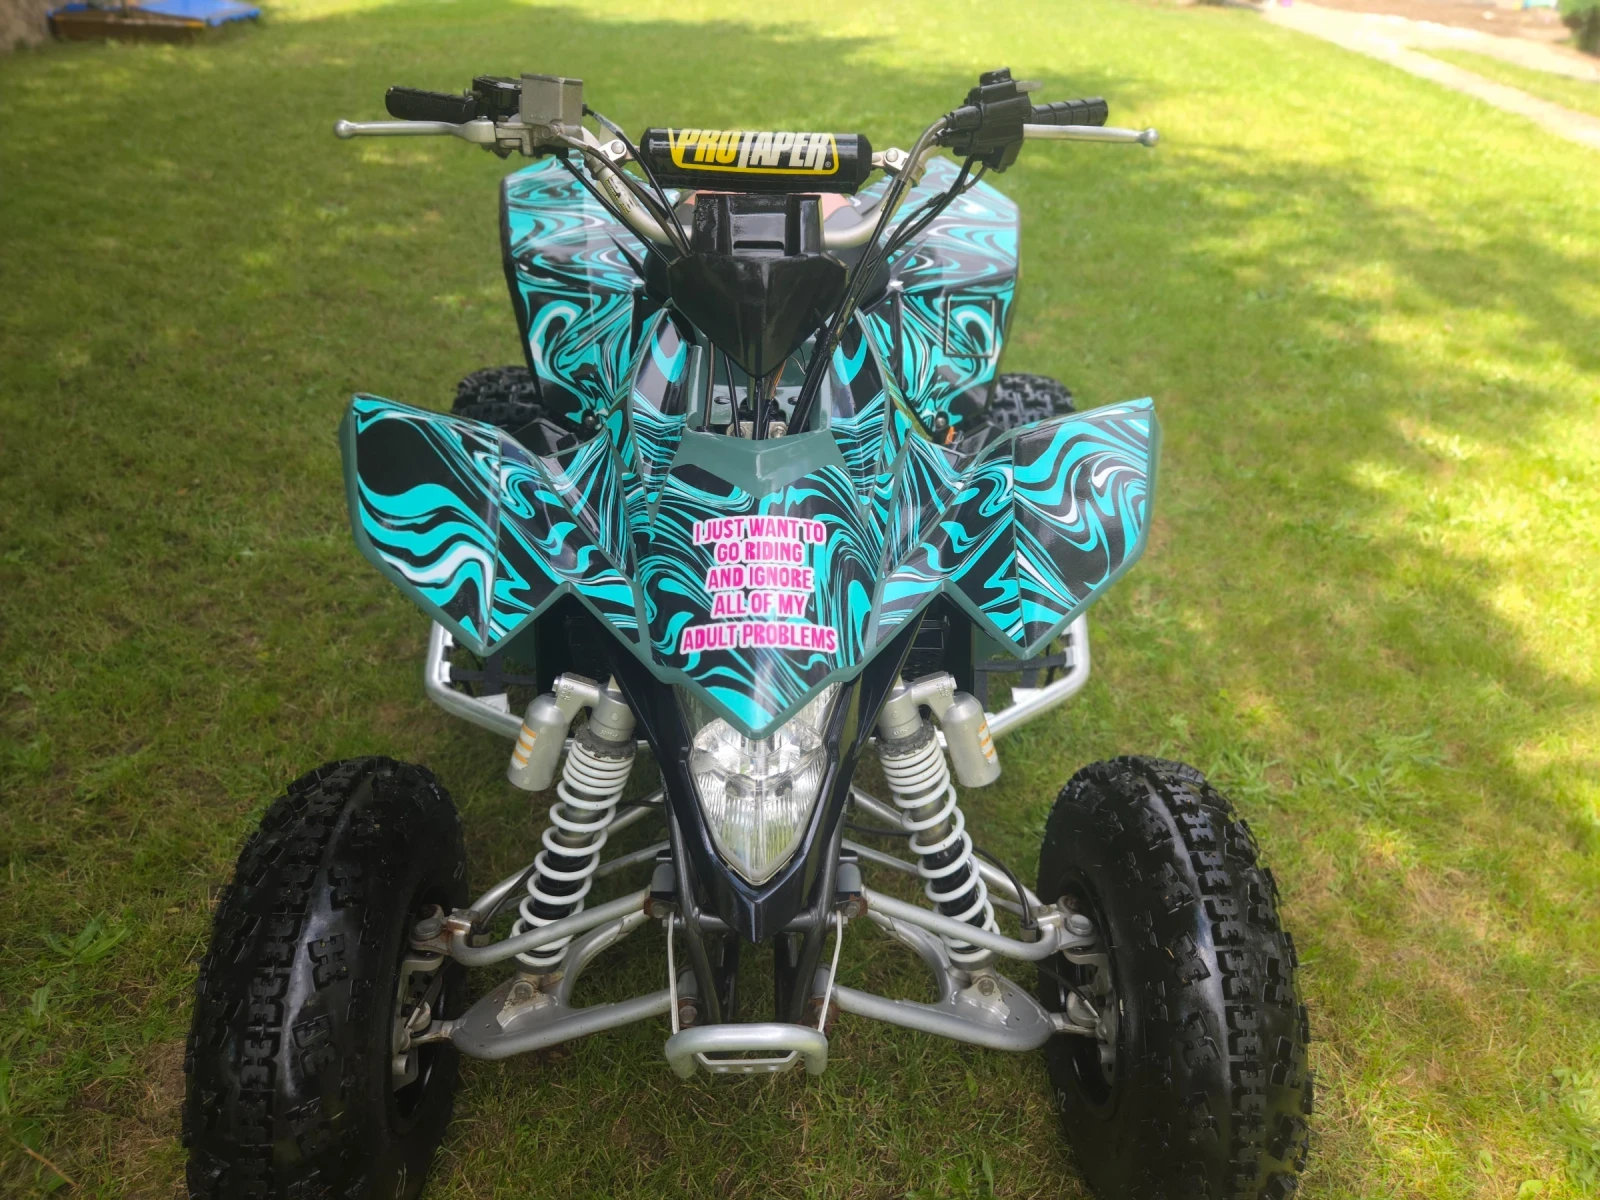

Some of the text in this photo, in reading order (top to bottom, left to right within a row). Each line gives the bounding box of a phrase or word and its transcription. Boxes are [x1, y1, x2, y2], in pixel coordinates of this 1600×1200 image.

[695, 518, 825, 543] I JUST WANT TO
[716, 541, 803, 563] GO RIDING
[707, 566, 812, 589] AND IGNORE
[713, 593, 806, 615] ALL OF MY
[683, 623, 836, 651] ADULT PROBLEMS
